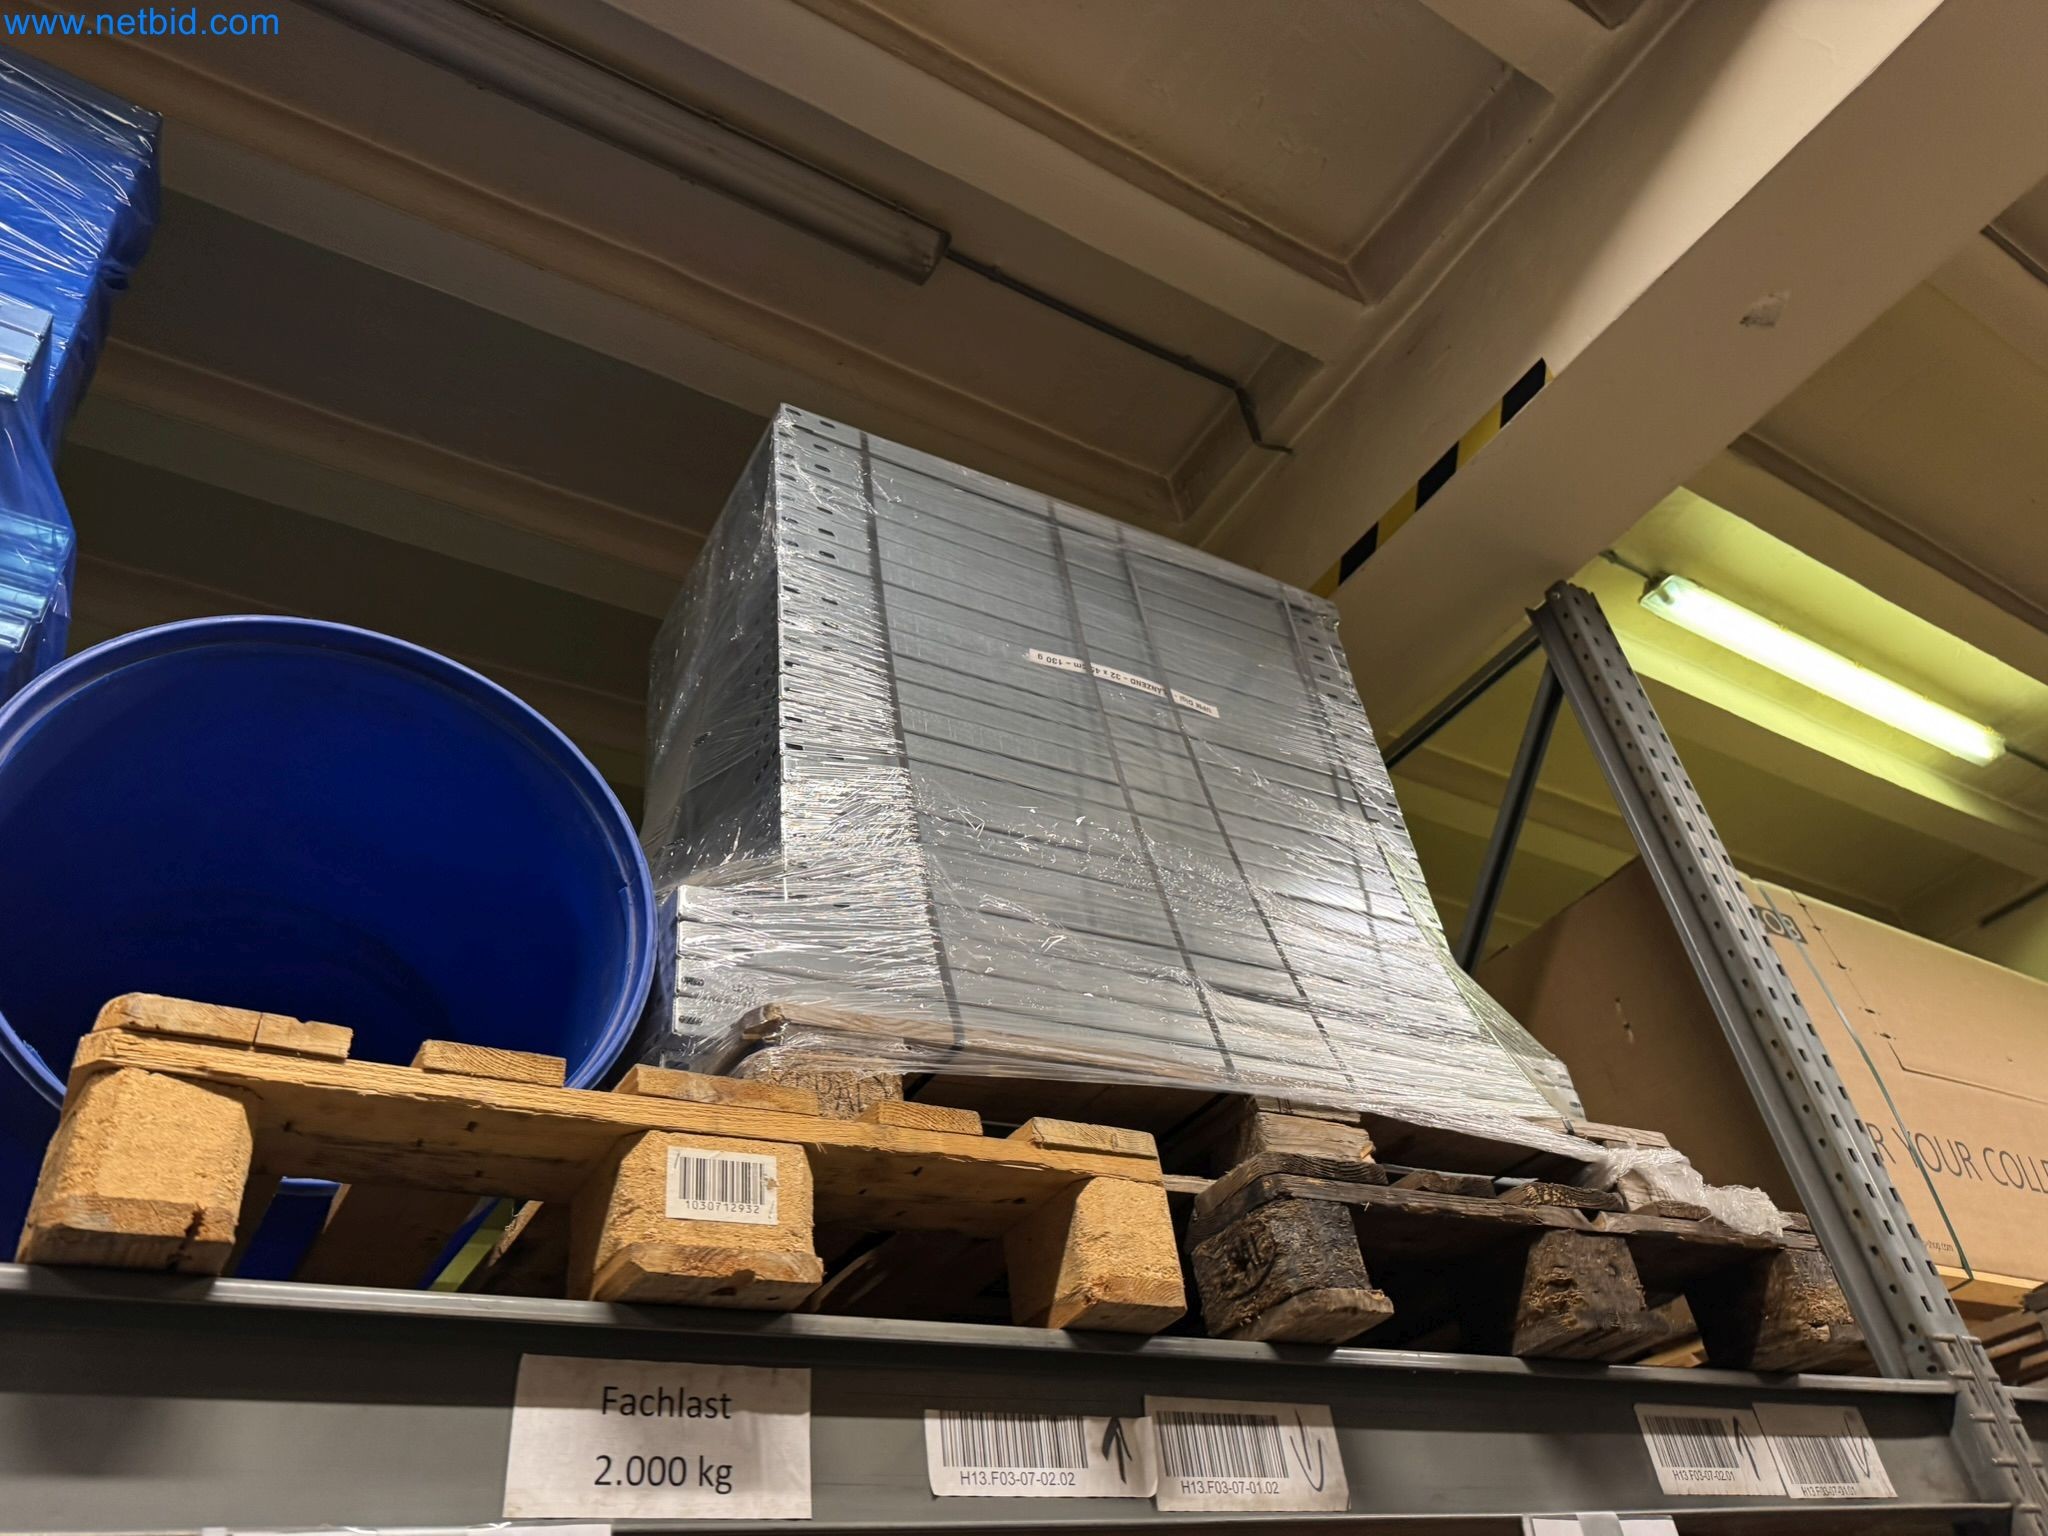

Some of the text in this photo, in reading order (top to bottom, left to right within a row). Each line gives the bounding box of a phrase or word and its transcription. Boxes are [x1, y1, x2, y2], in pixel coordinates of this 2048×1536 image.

[1046, 656, 1063, 666] 130
[1891, 1126, 1983, 1182] YOUR
[685, 1200, 761, 1214] 1030712932
[601, 1385, 734, 1420] Fachlast
[593, 1454, 734, 1496] 2.000 kg
[959, 1470, 1076, 1487] H13.F03-07-02.02
[1181, 1480, 1281, 1496] H13.F03-07-01.02
